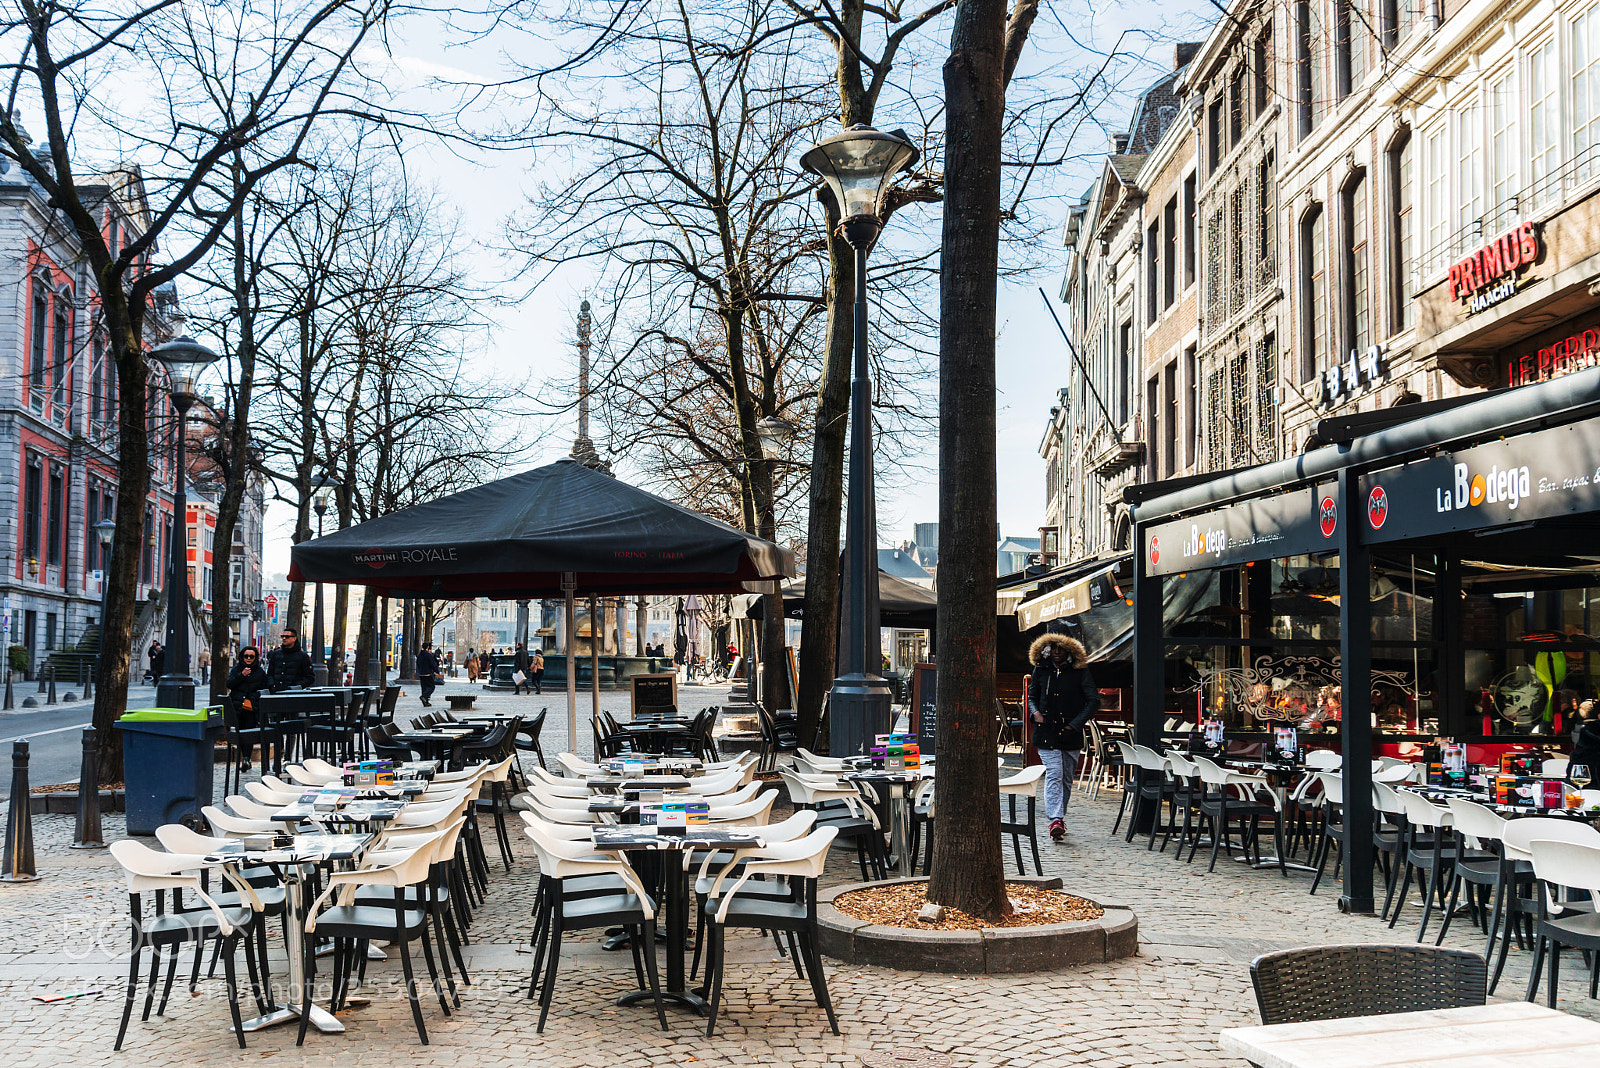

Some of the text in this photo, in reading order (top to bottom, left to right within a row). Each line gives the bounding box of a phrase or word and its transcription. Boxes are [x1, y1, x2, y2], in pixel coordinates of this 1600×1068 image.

[1448, 221, 1537, 302] PRIMUS
[1470, 278, 1517, 313] HAACHT
[1436, 487, 1452, 513] La
[1454, 462, 1531, 510] Bodega
[354, 547, 458, 562] MARTINI ROYALE
[613, 551, 647, 559] TORINO
[658, 551, 685, 559] ITALIA
[1183, 540, 1191, 557] La
[1191, 524, 1226, 558] Bodega
